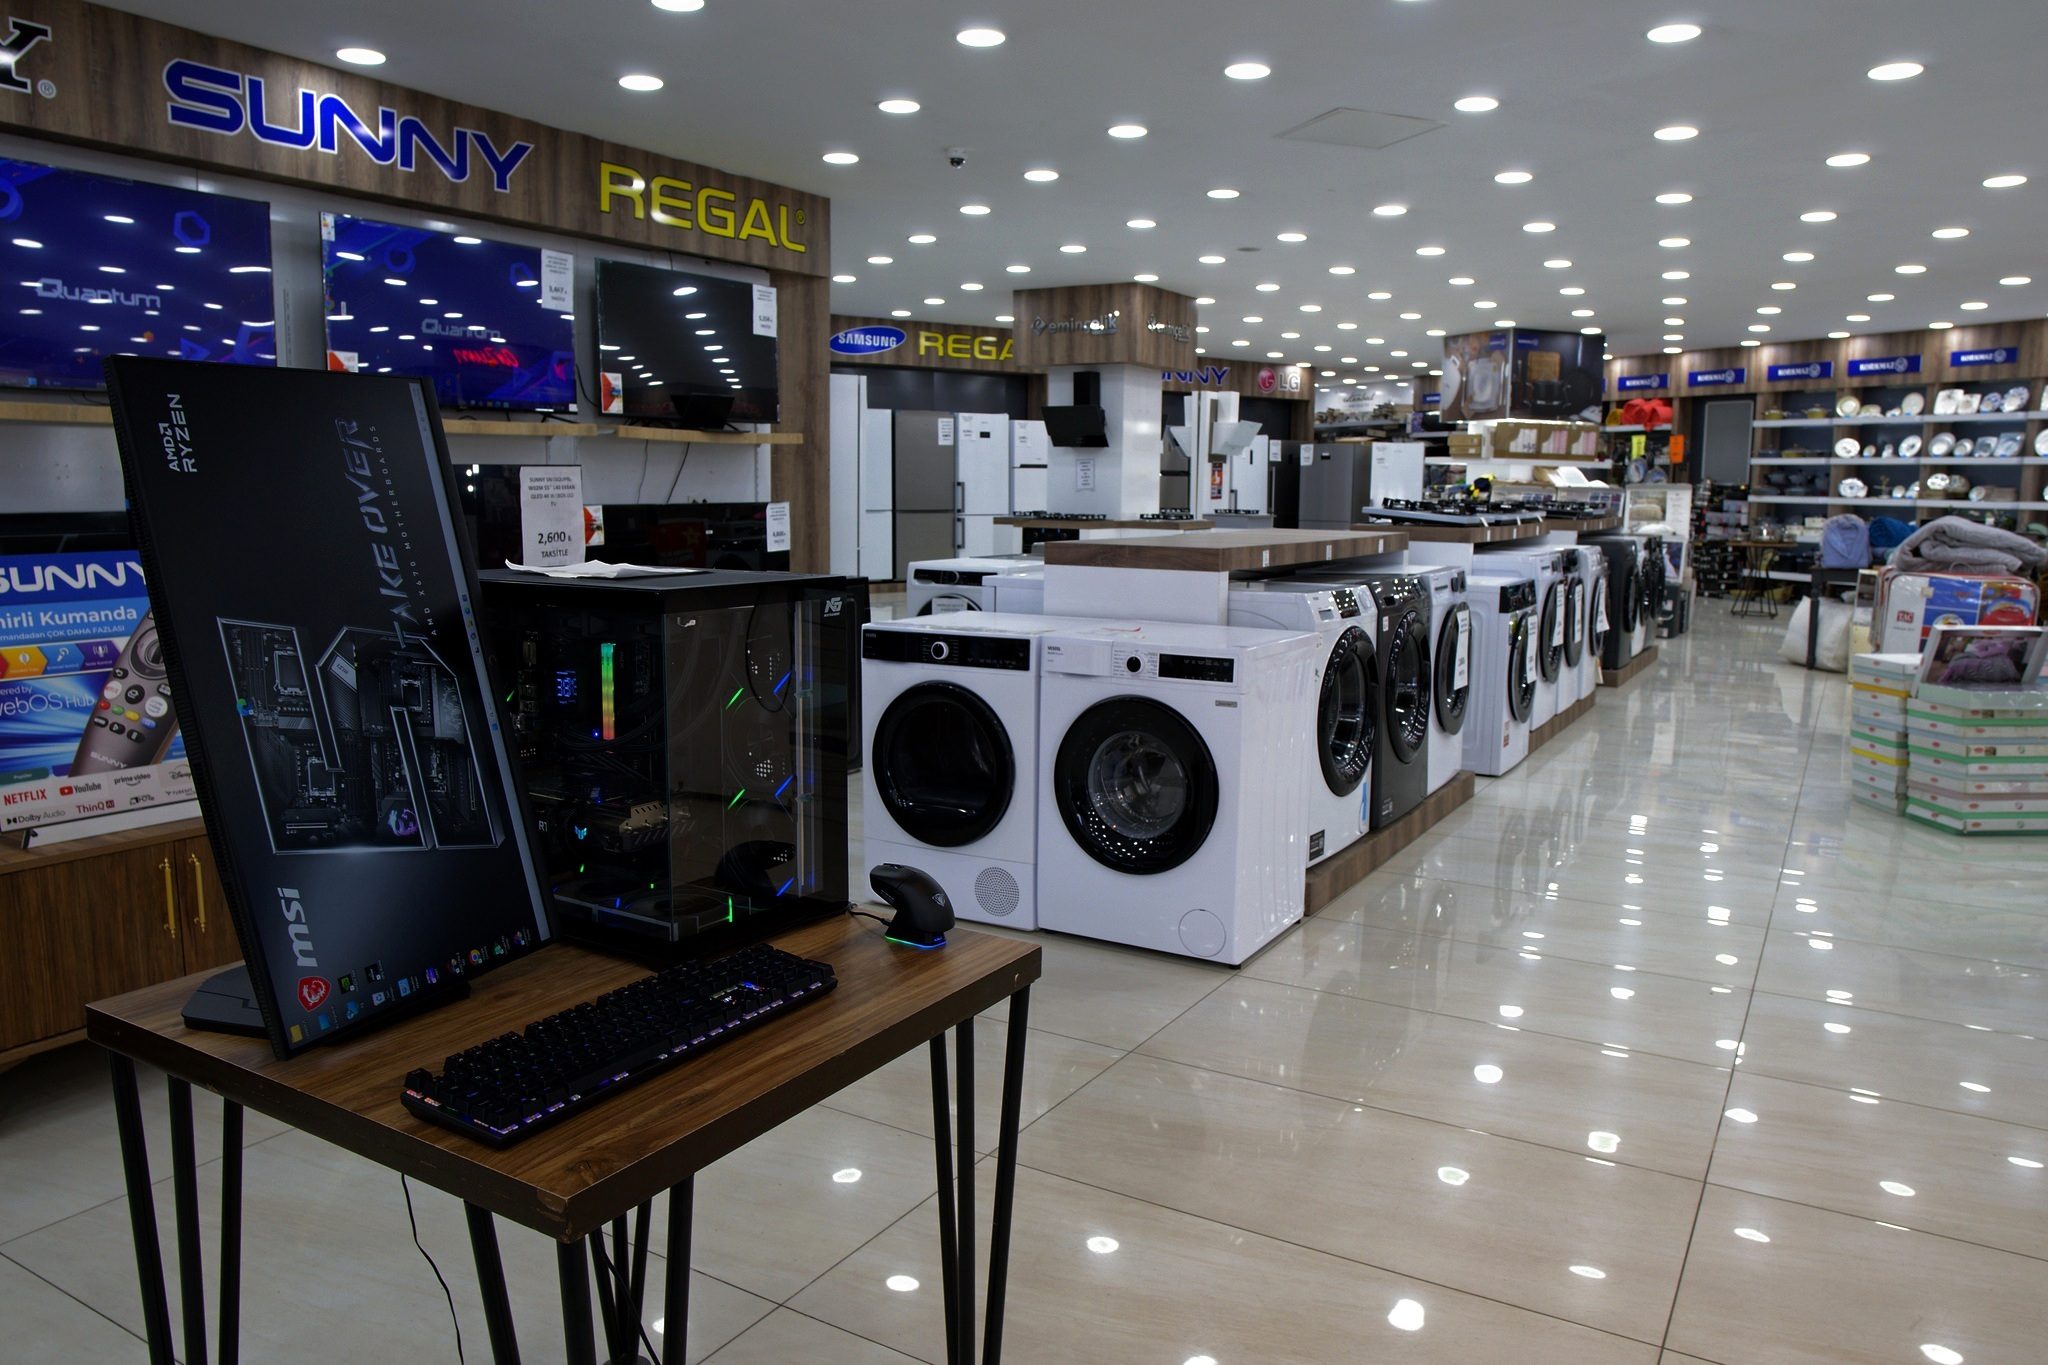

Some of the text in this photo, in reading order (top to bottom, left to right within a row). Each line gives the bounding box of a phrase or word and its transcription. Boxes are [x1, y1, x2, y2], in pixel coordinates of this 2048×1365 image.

[163, 58, 534, 193] SUNNY
[600, 161, 806, 253] REGAL
[34, 277, 160, 307] Quantum
[838, 332, 897, 348] SAMSUNG
[1279, 372, 1300, 391] LG
[166, 393, 198, 473] RYZEN
[164, 436, 181, 473] AMD
[334, 418, 389, 534] OVER
[369, 425, 438, 637] AMD X670 MOTHERBOARDS
[538, 531, 566, 545] 2,600
[541, 549, 568, 558] TAKSİTLE
[0, 561, 146, 594] UNN
[40, 606, 137, 627] Kumanda
[47, 629, 65, 639] ÇOK
[67, 628, 91, 636] DAHA
[93, 625, 125, 634] FAZLASI
[21, 686, 33, 695] by
[65, 694, 96, 708] Hub
[74, 782, 102, 793] YouTube
[114, 775, 133, 784] prime
[4, 788, 47, 807] NETFLIX
[18, 809, 66, 824] Dolby Audio
[76, 802, 105, 814] ThinQ
[277, 886, 318, 967] msi
